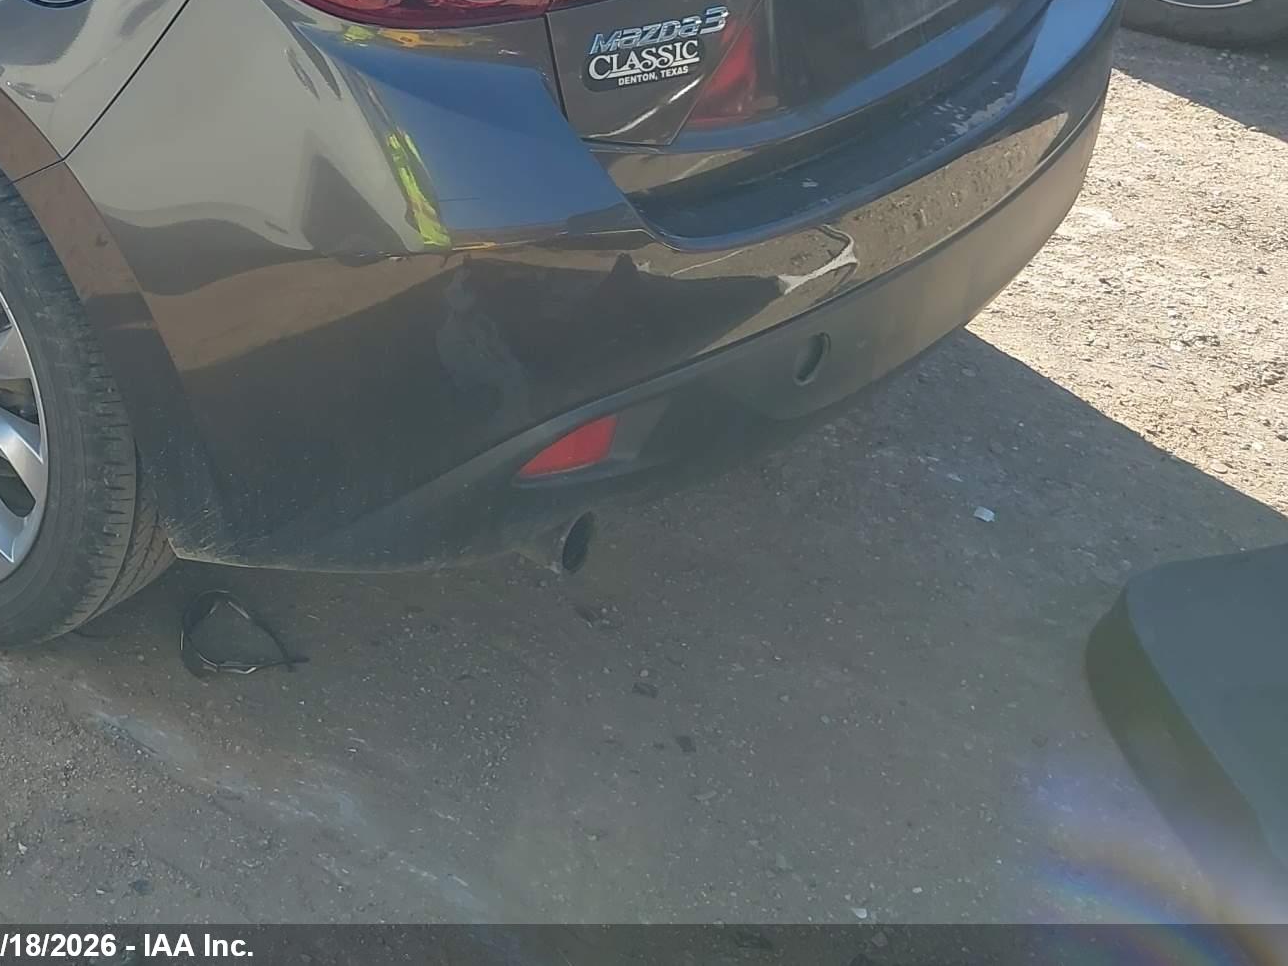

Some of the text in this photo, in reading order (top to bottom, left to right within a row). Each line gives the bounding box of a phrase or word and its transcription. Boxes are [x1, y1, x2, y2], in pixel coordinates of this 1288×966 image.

[588, 40, 700, 80] CLASSIC
[618, 65, 689, 86] DENTON, TEXAS
